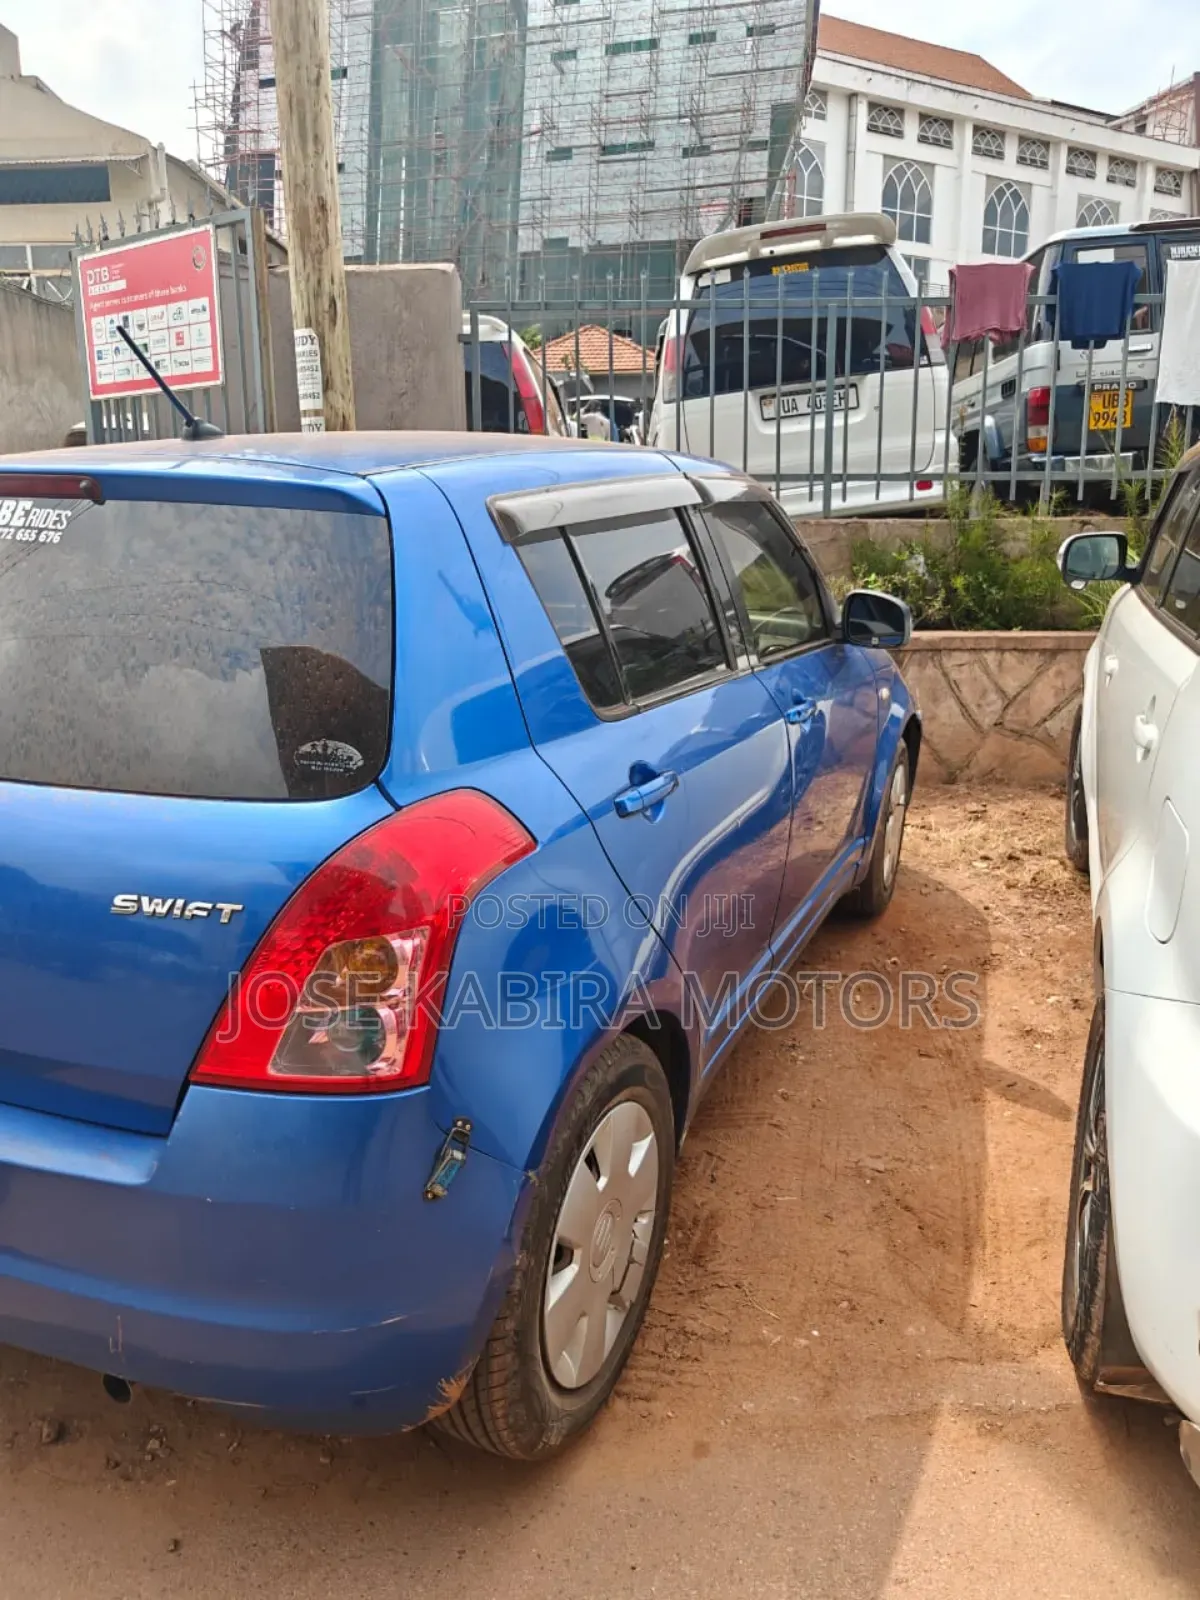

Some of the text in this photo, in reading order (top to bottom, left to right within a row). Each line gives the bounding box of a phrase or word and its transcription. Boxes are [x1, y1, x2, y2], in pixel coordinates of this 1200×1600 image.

[87, 266, 110, 285] DTB
[1094, 382, 1137, 391] PRAO
[781, 398, 799, 414] UA
[0, 499, 72, 530] BE RIDES
[16, 528, 38, 542] 655
[38, 530, 63, 544] 676
[110, 894, 243, 924] SWIFT
